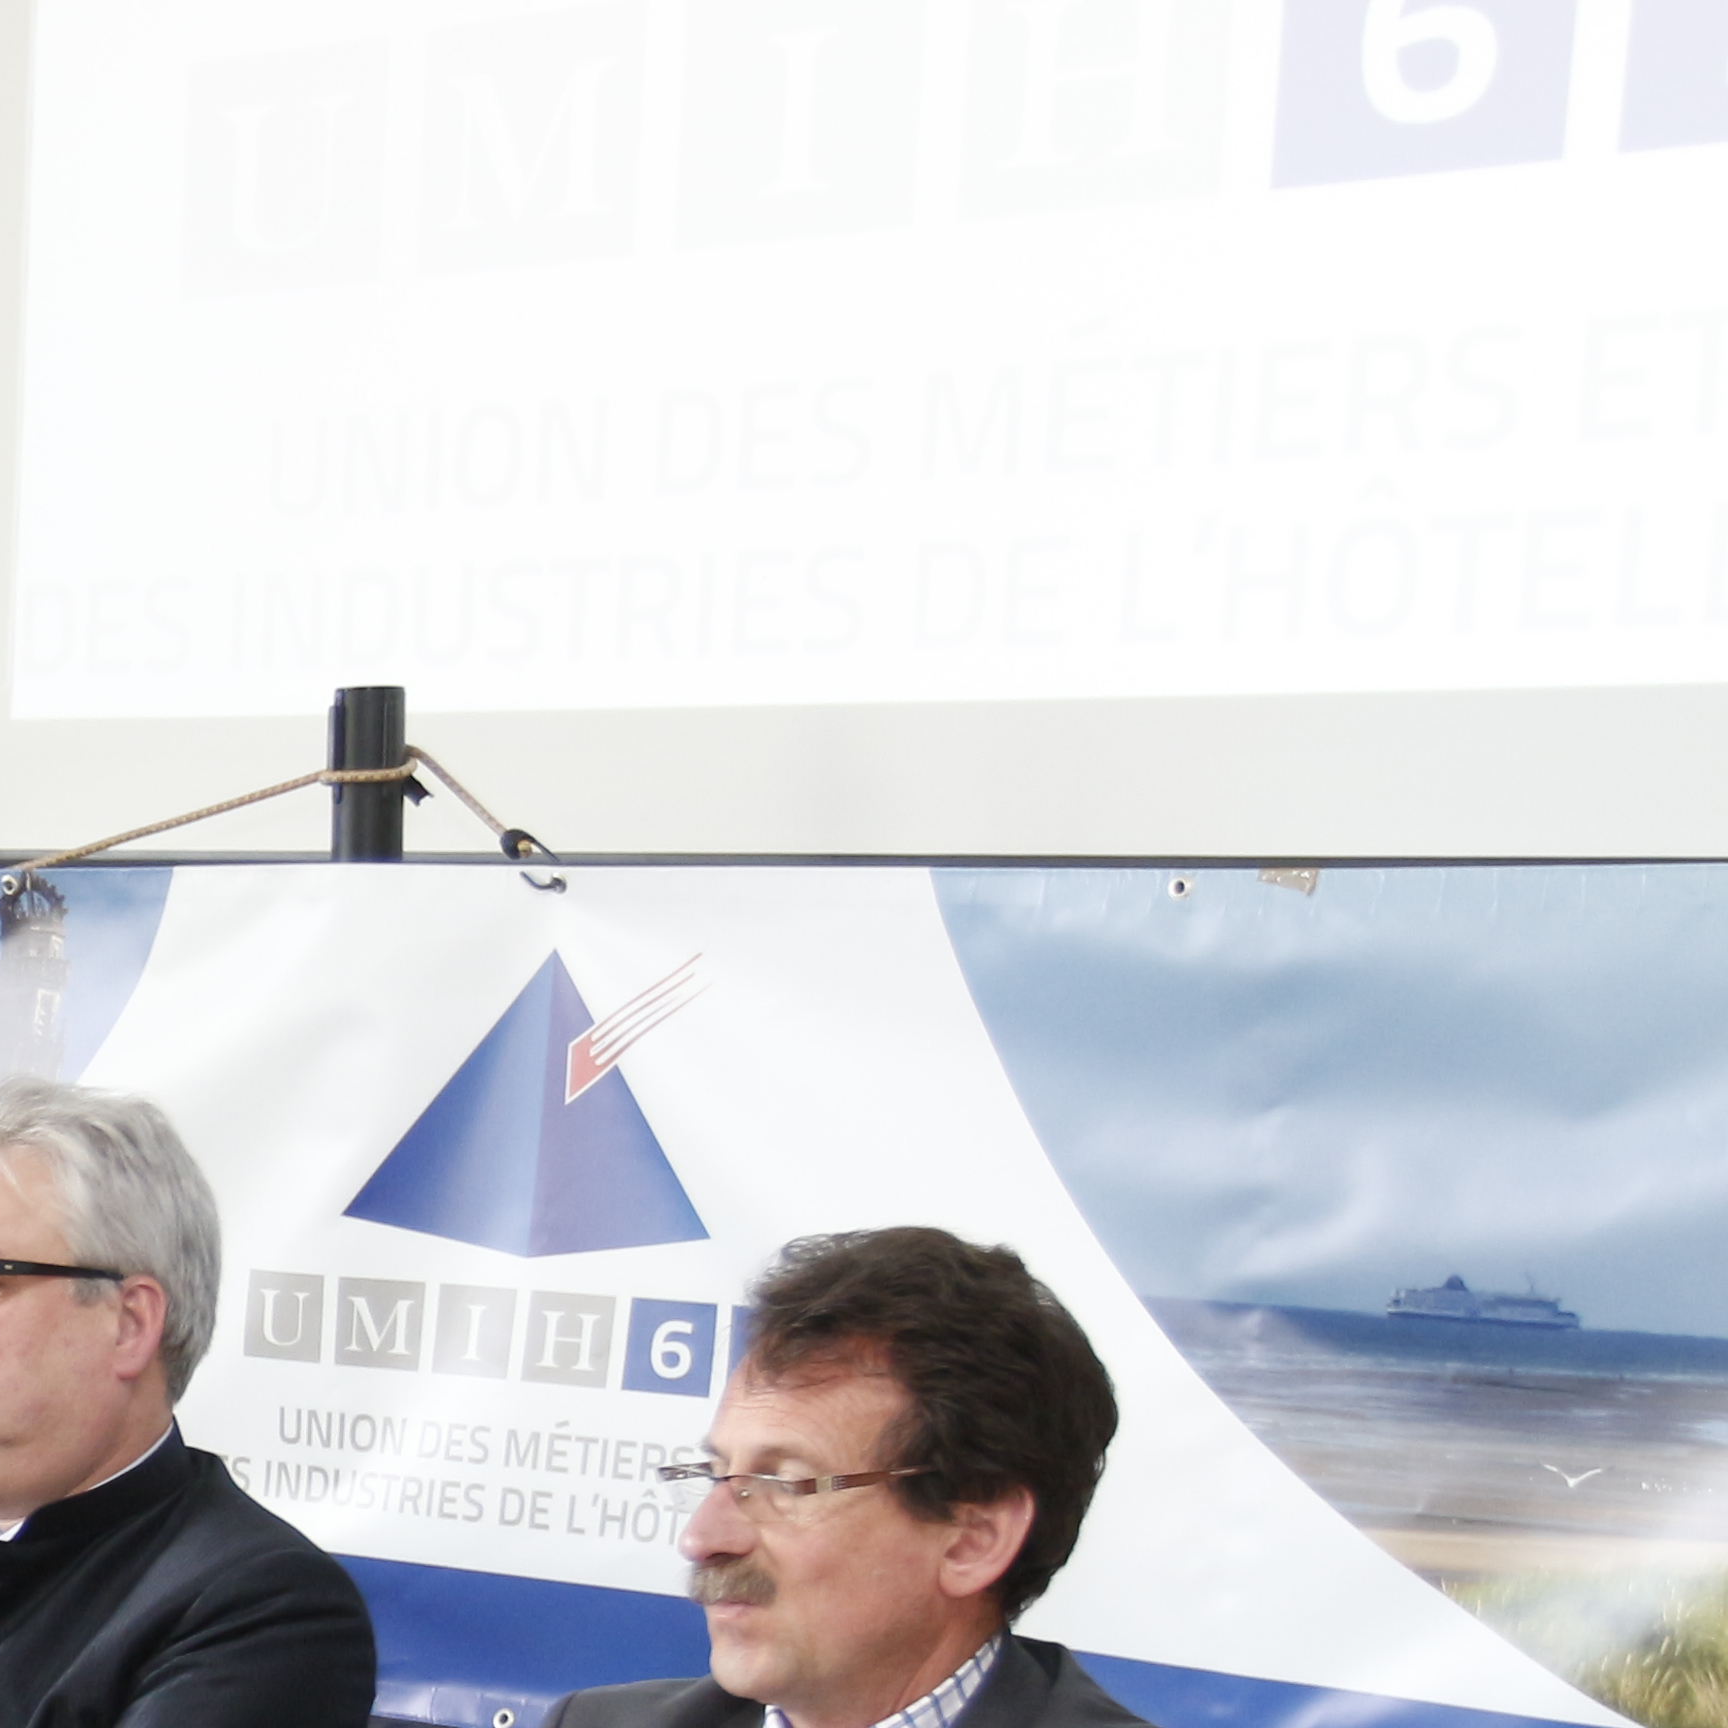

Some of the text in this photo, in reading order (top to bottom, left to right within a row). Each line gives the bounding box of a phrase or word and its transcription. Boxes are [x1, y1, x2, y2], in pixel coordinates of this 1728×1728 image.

[259, 1287, 602, 1373] UMIH
[277, 1405, 408, 1458] UNION
[417, 1420, 493, 1464] DES
[262, 1459, 486, 1523] INDUSTRIES
[498, 1486, 552, 1532] DE
[565, 1488, 690, 1546] L'HÔT
